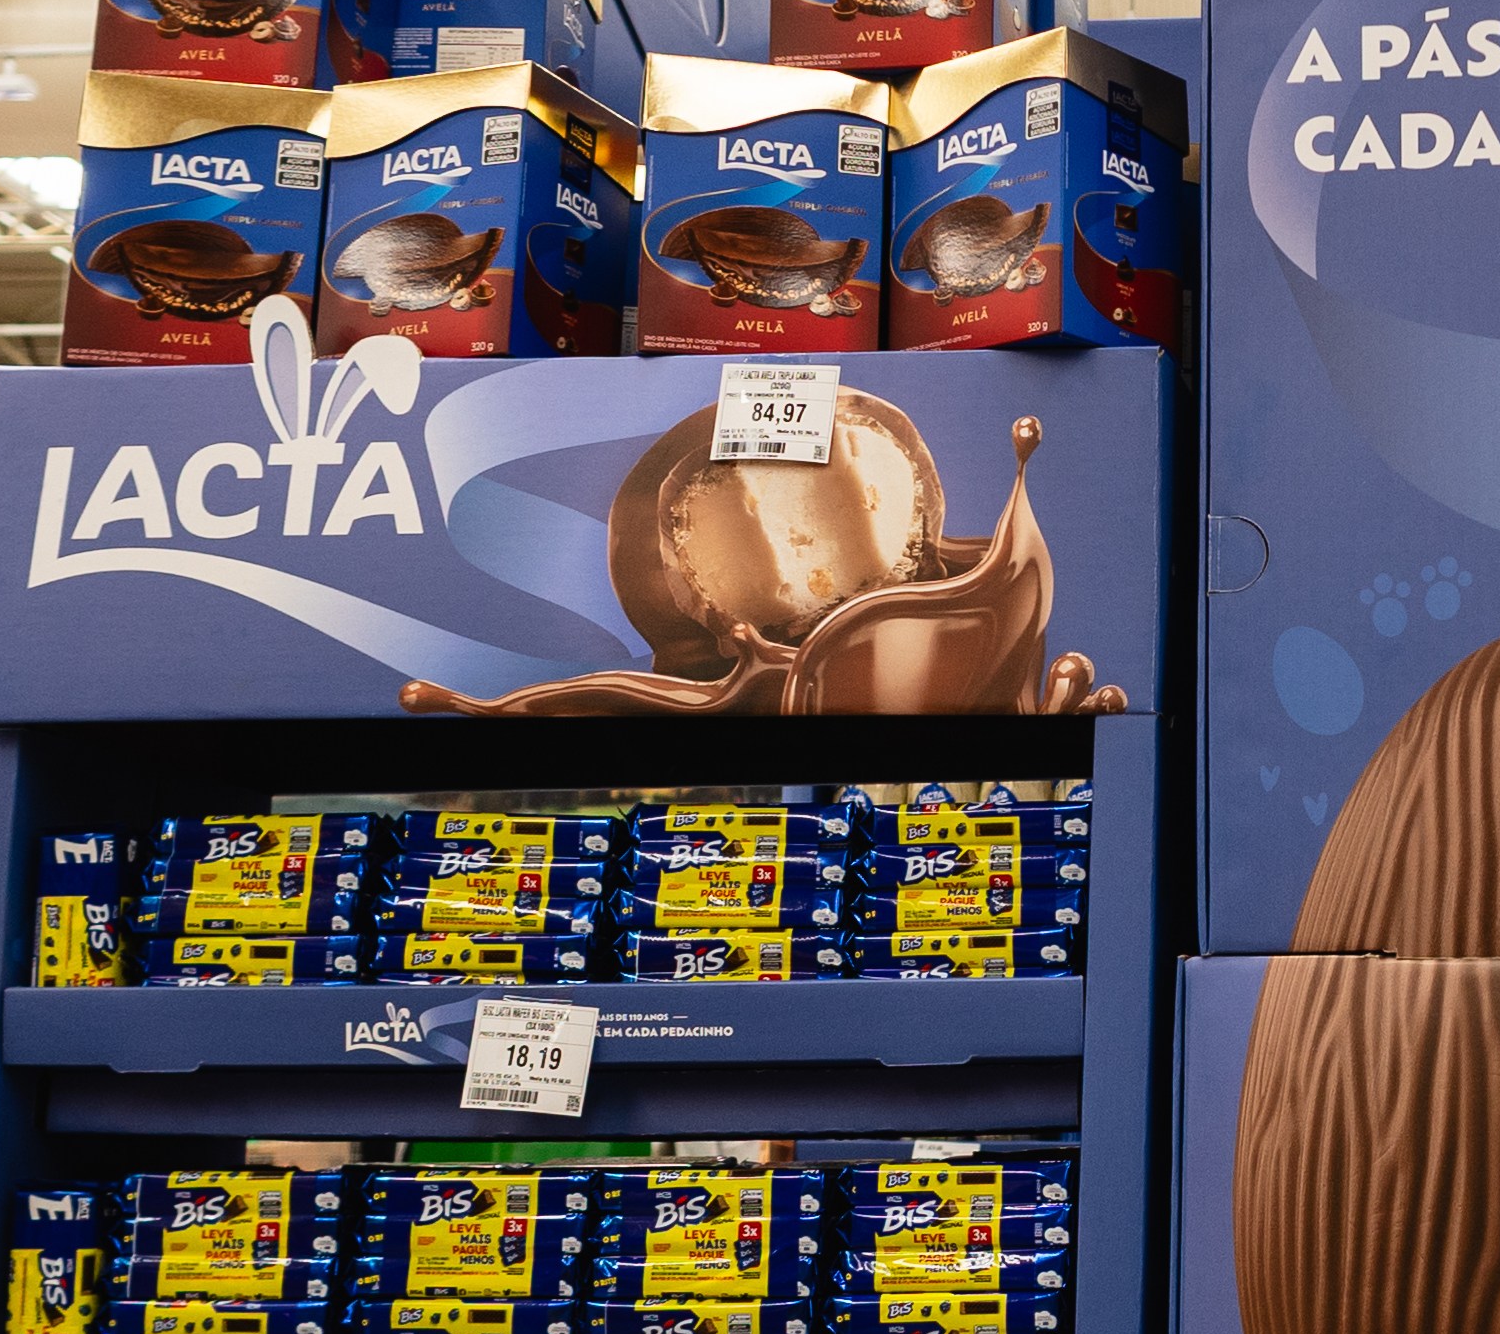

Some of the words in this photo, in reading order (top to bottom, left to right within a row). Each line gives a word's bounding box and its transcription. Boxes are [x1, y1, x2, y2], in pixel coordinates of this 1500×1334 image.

[422, 1, 456, 12] AVELÃ
[857, 28, 903, 43] AVELÃ
[179, 48, 226, 61] AVELÃ
[1286, 28, 1342, 84] A
[938, 123, 1013, 171] LACTA
[382, 146, 468, 185] LACTA
[718, 137, 821, 180] LACTA
[152, 153, 257, 190] LACTA
[1103, 150, 1152, 191] LACTA
[556, 183, 601, 227] LACTA
[952, 308, 989, 327] AVELÃ
[389, 321, 429, 337] AVELÃ
[735, 319, 785, 334] AVELÃ
[1028, 321, 1041, 333] 320
[161, 333, 211, 347] AVELÃ
[470, 341, 484, 352] 320
[752, 403, 807, 425] 84,97
[28, 437, 424, 588] LACTA
[206, 831, 258, 861] BIS
[905, 846, 957, 880] BIS
[644, 1013, 668, 1021] ANOS
[345, 1020, 422, 1052] LACTA
[604, 1027, 622, 1037] EM
[625, 1027, 657, 1037] CADA
[660, 1026, 733, 1037] PEDACINHO
[506, 1044, 562, 1072] 18,19
[420, 1191, 471, 1225] BIS
[449, 1224, 481, 1235] LEVE
[505, 1220, 523, 1233] 3x
[460, 1234, 491, 1245] MAIS
[452, 1245, 488, 1256] PAGUE
[459, 1255, 495, 1265] MENOS
